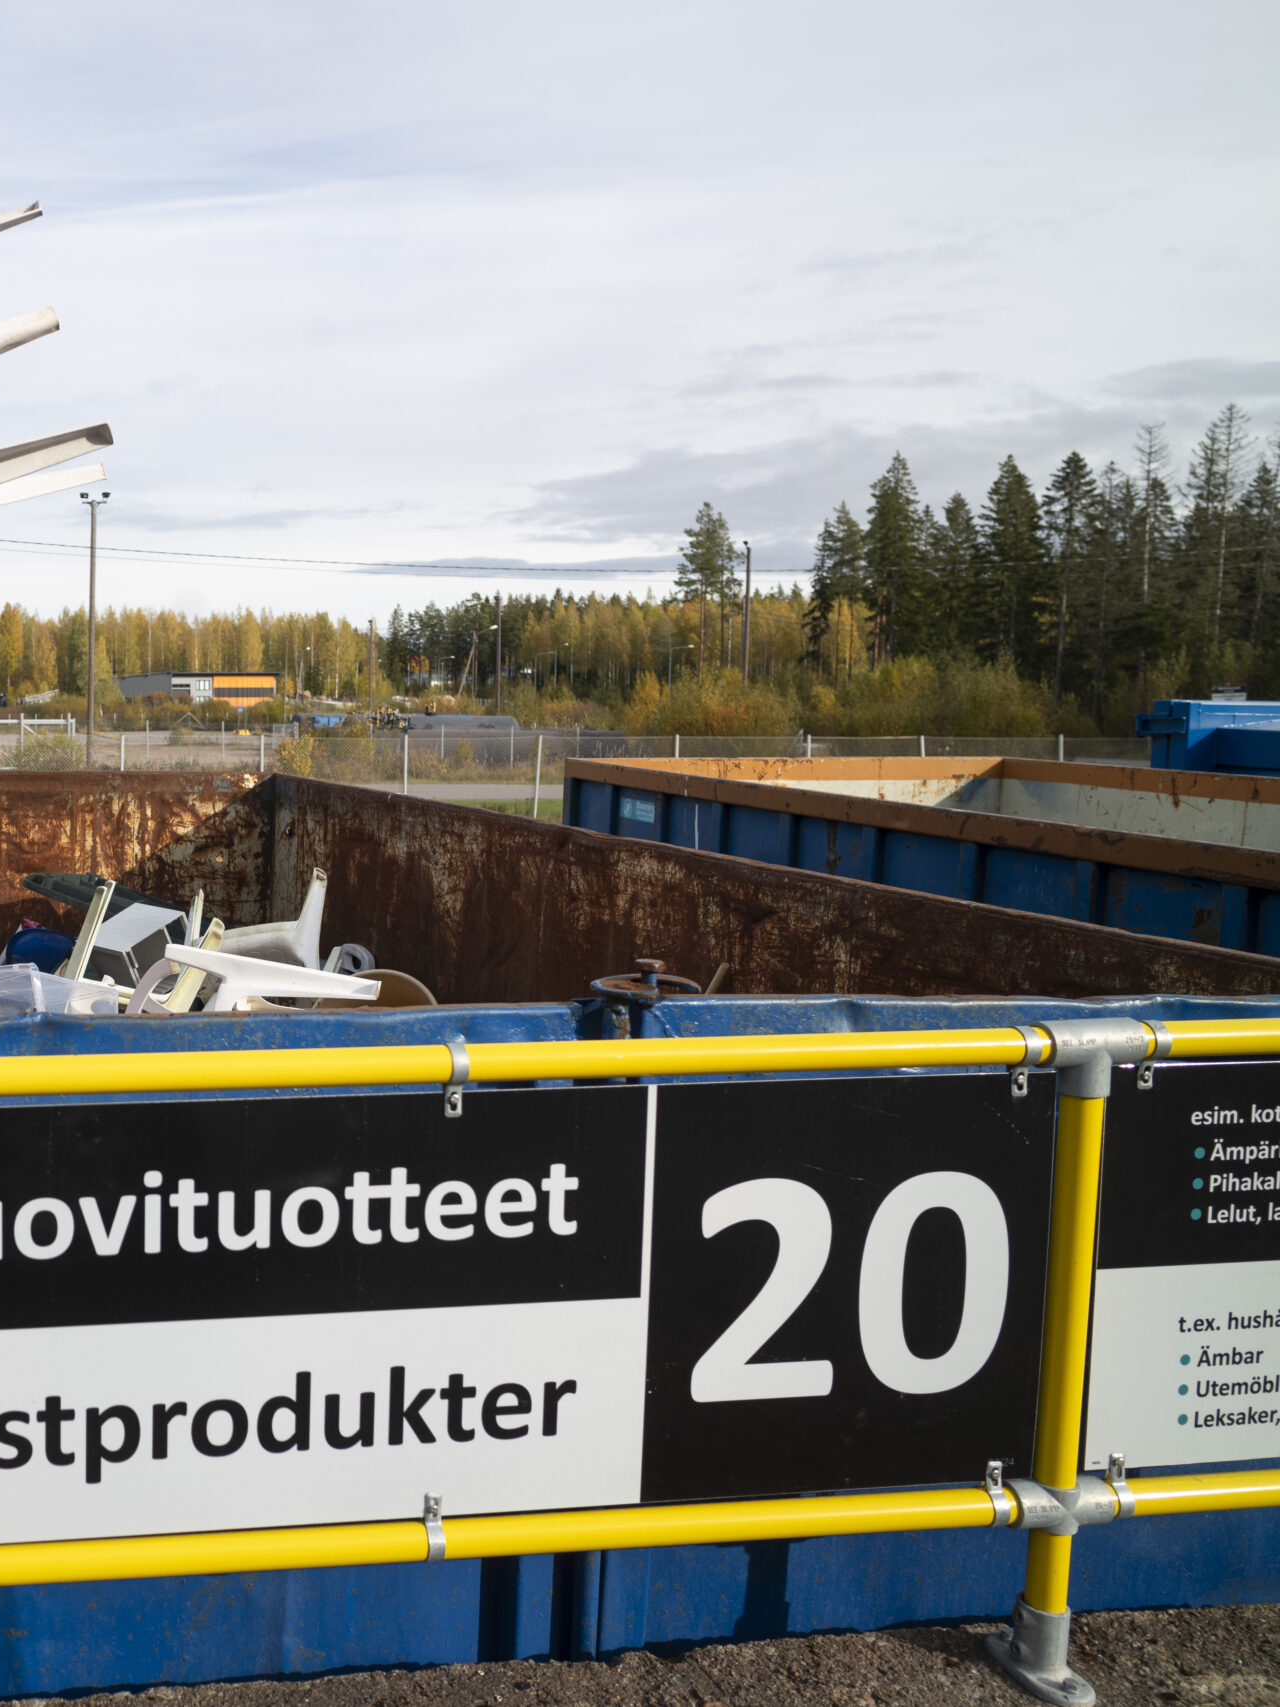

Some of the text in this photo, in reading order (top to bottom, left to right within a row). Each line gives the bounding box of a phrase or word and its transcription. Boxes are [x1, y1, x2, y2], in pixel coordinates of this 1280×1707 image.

[1190, 1105, 1244, 1126] esim.
[1209, 1170, 1280, 1193] Pihakal
[1207, 1203, 1262, 1225] Lelut,
[690, 1171, 1010, 1403] 20
[1178, 1316, 1221, 1333] t.ex.
[1197, 1345, 1264, 1368] Ämbar
[1196, 1374, 1280, 1398] Utemöbl
[1194, 1406, 1280, 1429] Leksaker,
